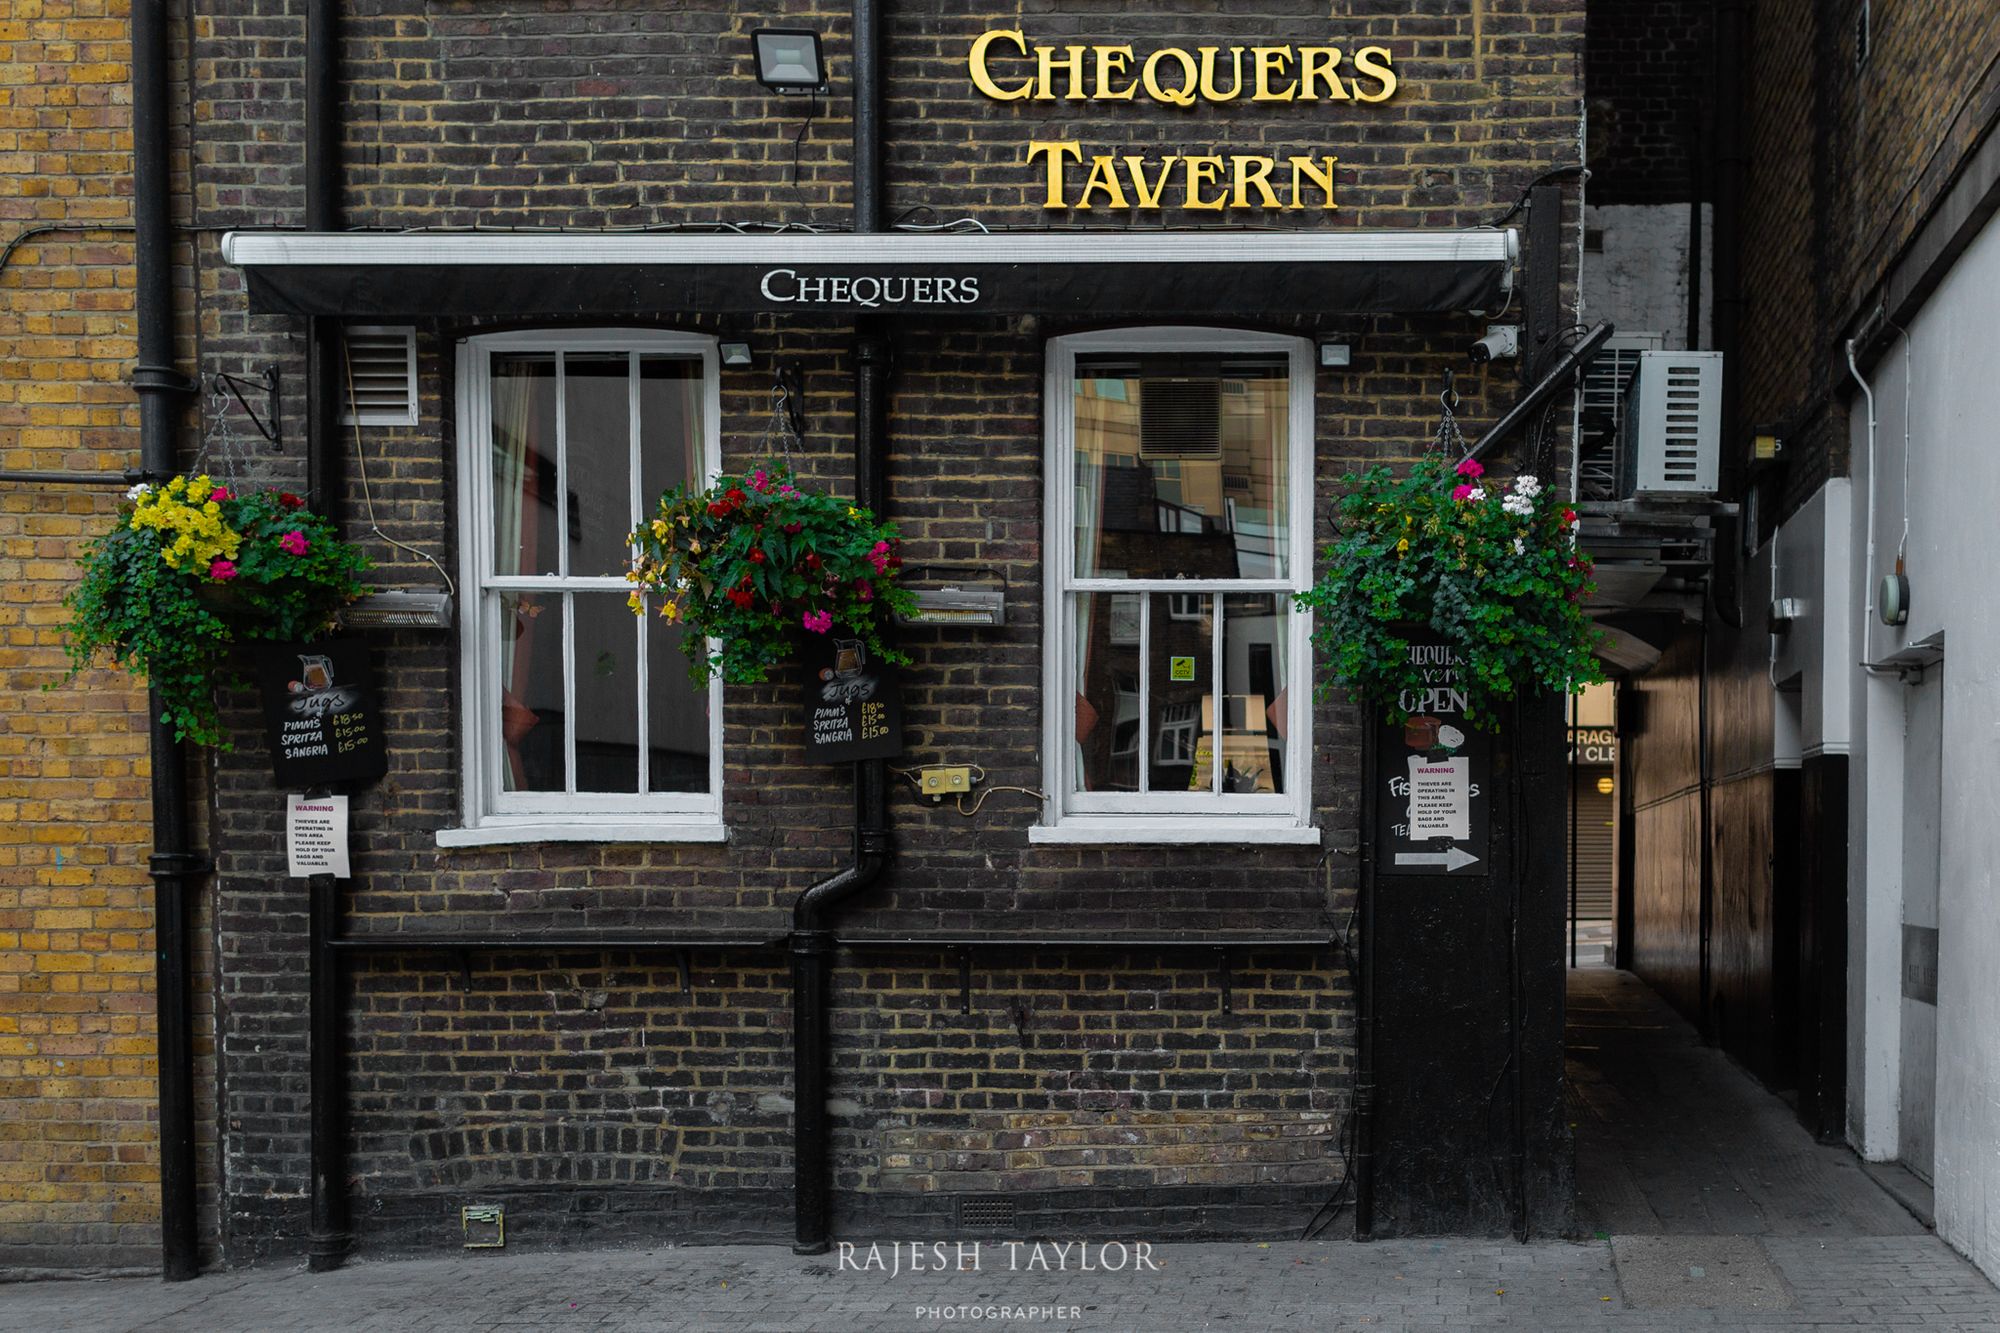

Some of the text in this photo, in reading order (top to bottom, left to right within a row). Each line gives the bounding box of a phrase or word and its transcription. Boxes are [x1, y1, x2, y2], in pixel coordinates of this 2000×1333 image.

[968, 29, 1398, 108] CHEQUERS
[1026, 140, 1339, 212] TAVERN
[760, 269, 980, 308] CHEQUERS
[829, 683, 870, 698] Jugs
[1398, 687, 1468, 713] OPEN
[814, 704, 846, 719] PIMM'S
[283, 716, 321, 732] PIMM'S
[814, 717, 848, 732] SPRITZA
[281, 730, 323, 746] SPRITZA
[814, 728, 853, 745] SANGRIA
[285, 744, 328, 759] SANGRIA
